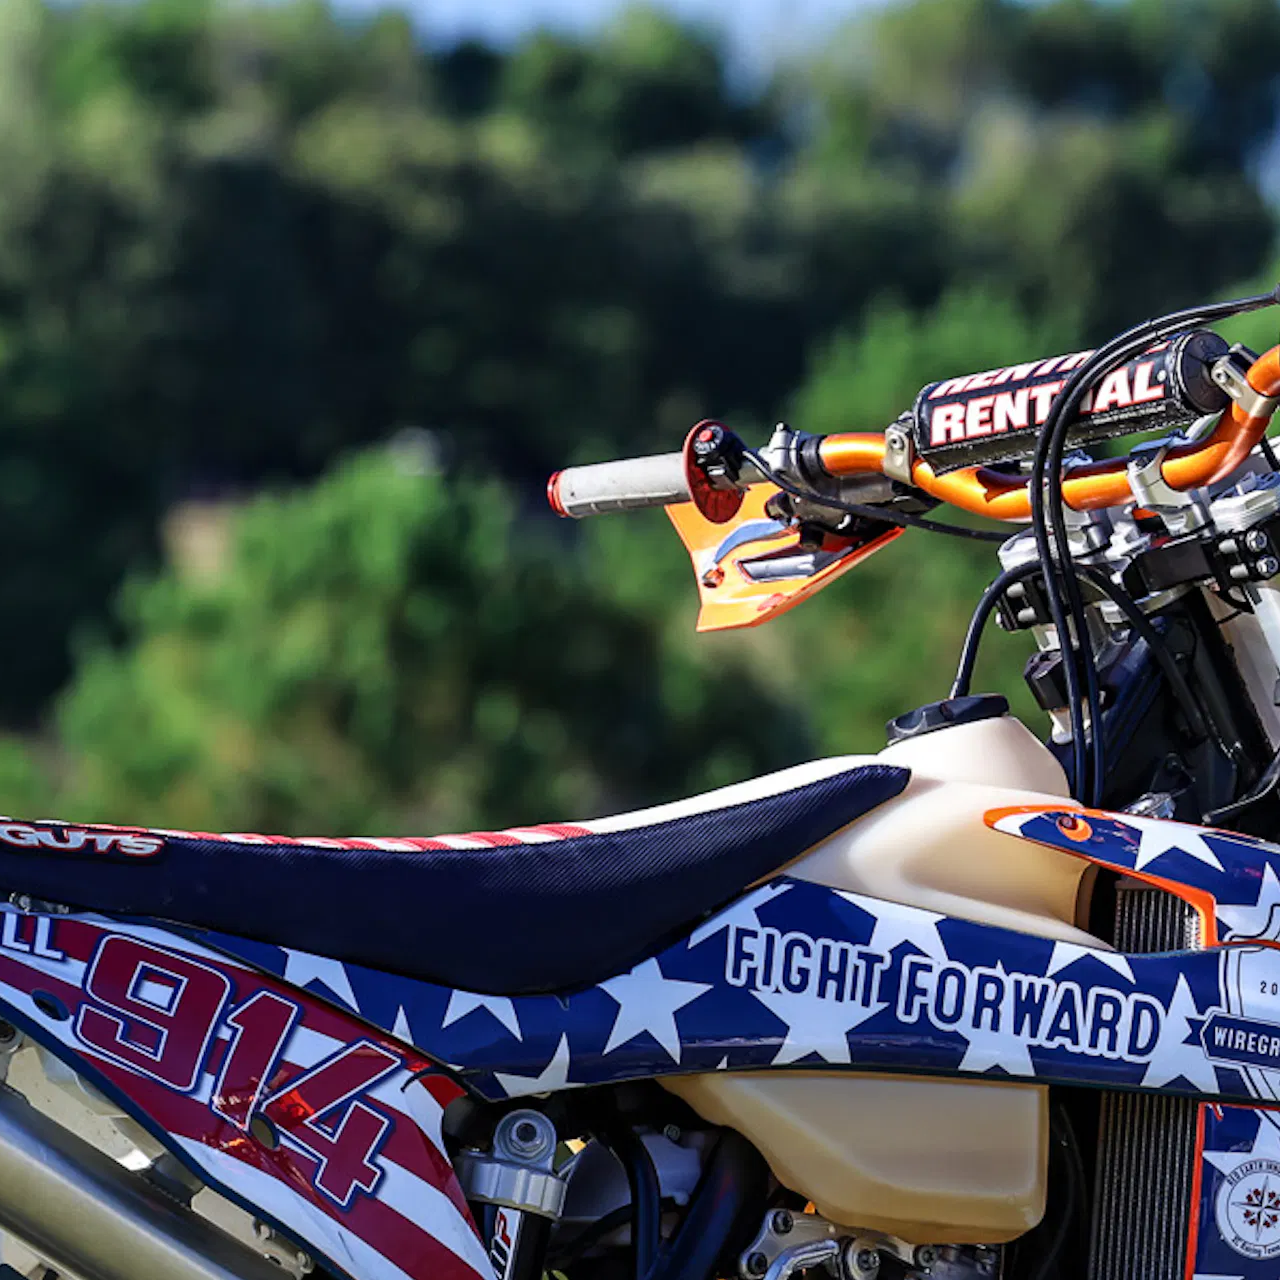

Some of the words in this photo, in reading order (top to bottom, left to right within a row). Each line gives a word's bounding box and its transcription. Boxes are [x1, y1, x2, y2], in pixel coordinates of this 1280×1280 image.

[73, 931, 407, 1209] 914
[725, 923, 891, 1004] FIGHT
[895, 951, 1168, 1064] FORWARD
